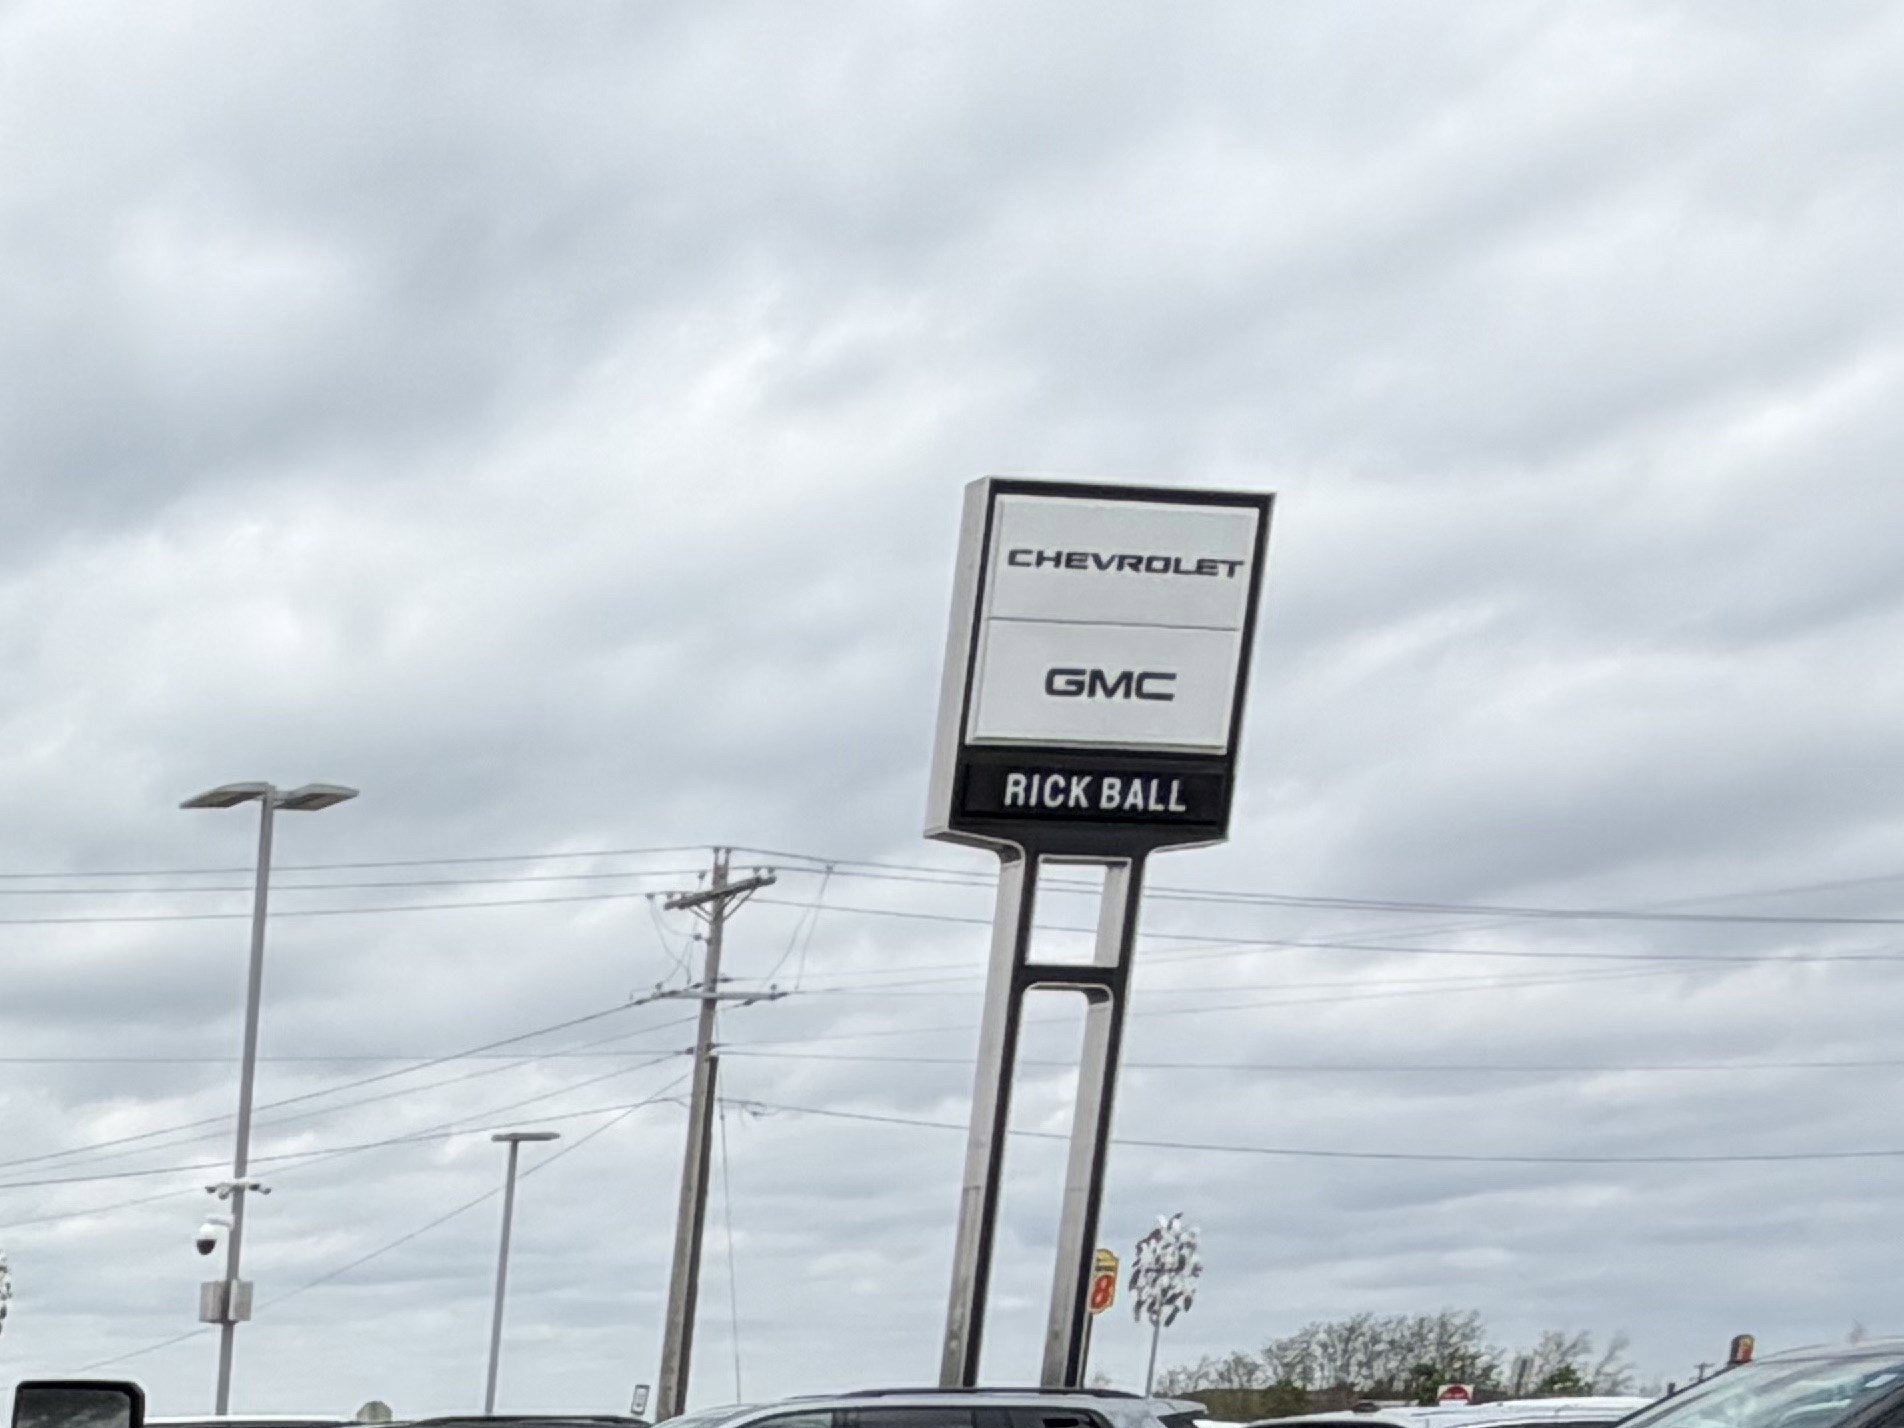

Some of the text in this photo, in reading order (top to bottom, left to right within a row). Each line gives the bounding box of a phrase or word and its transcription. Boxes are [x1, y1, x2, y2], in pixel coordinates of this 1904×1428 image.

[1008, 549, 1244, 578] CHEVROLET
[1045, 668, 1177, 701] GMC
[1004, 773, 1187, 812] RICK BALL
